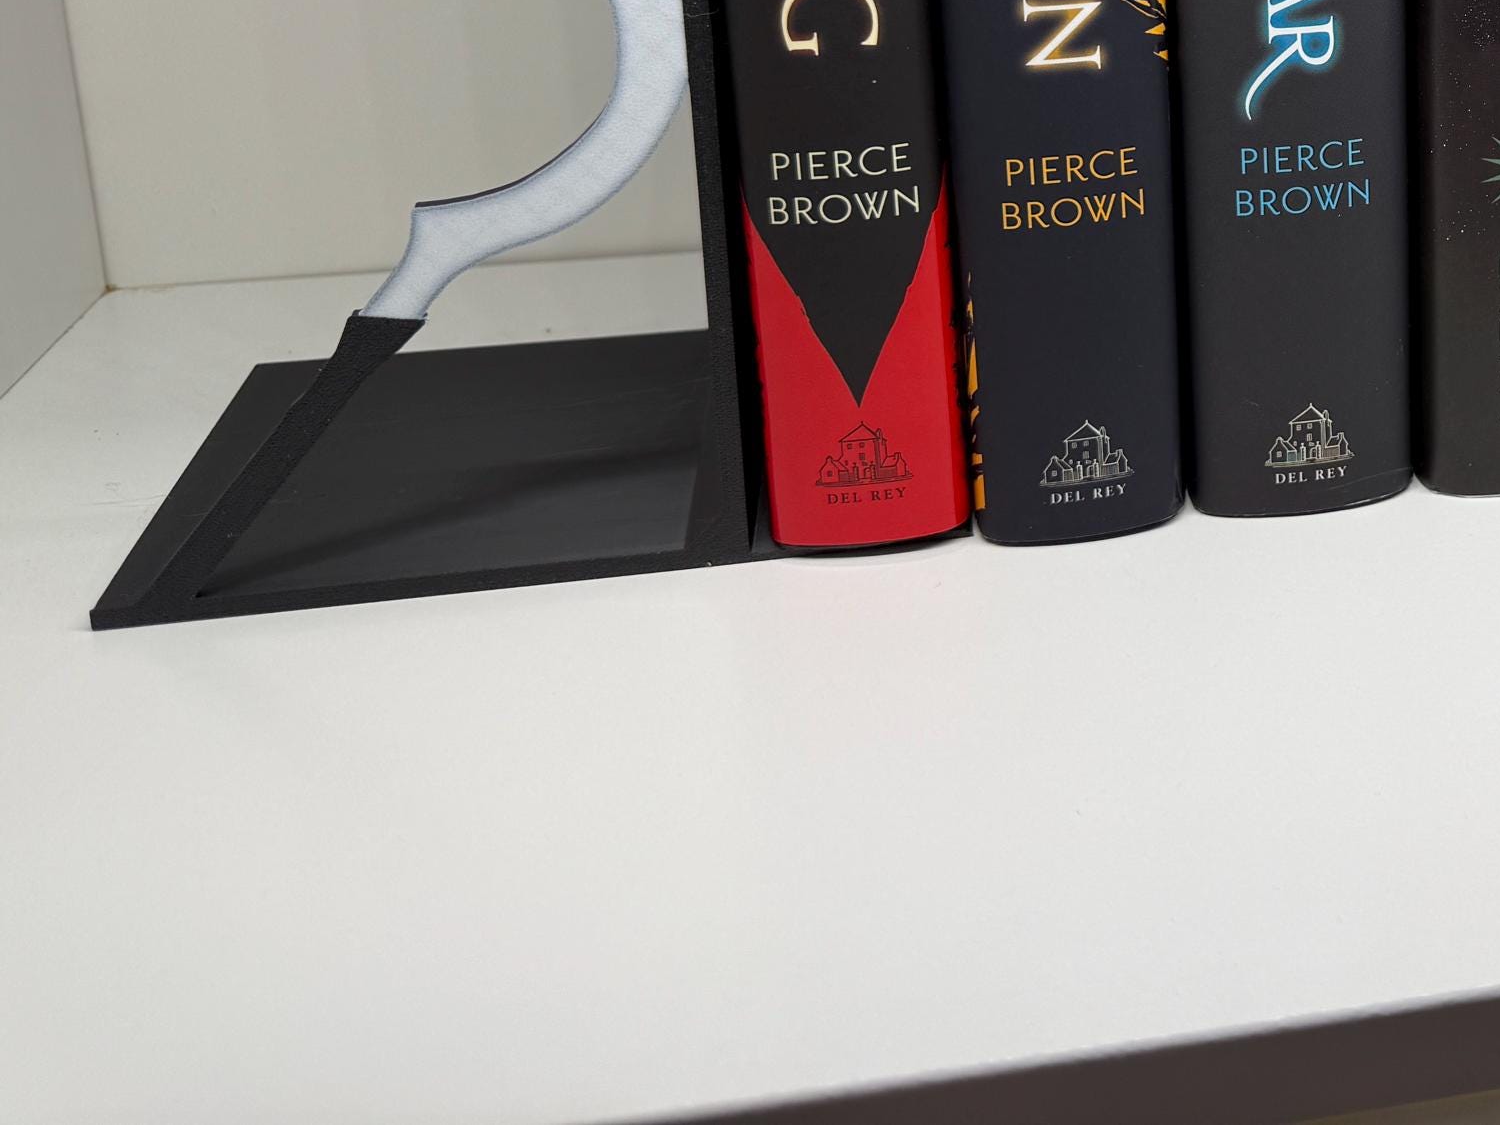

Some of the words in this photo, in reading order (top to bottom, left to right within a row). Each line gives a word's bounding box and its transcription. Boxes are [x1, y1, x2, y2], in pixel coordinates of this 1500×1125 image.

[771, 142, 912, 181] PIERCE
[1005, 146, 1138, 187] PIERCE
[1239, 138, 1365, 175] PIERCE
[768, 185, 921, 226] BROWN
[1001, 188, 1146, 231] BROWN
[1234, 178, 1371, 218] BROWN
[1049, 487, 1086, 505] DEL
[1092, 482, 1127, 500] REY
[1274, 471, 1309, 485] DEL
[1315, 465, 1348, 481] REY
[826, 489, 864, 505] DEL
[871, 486, 909, 502] REY
